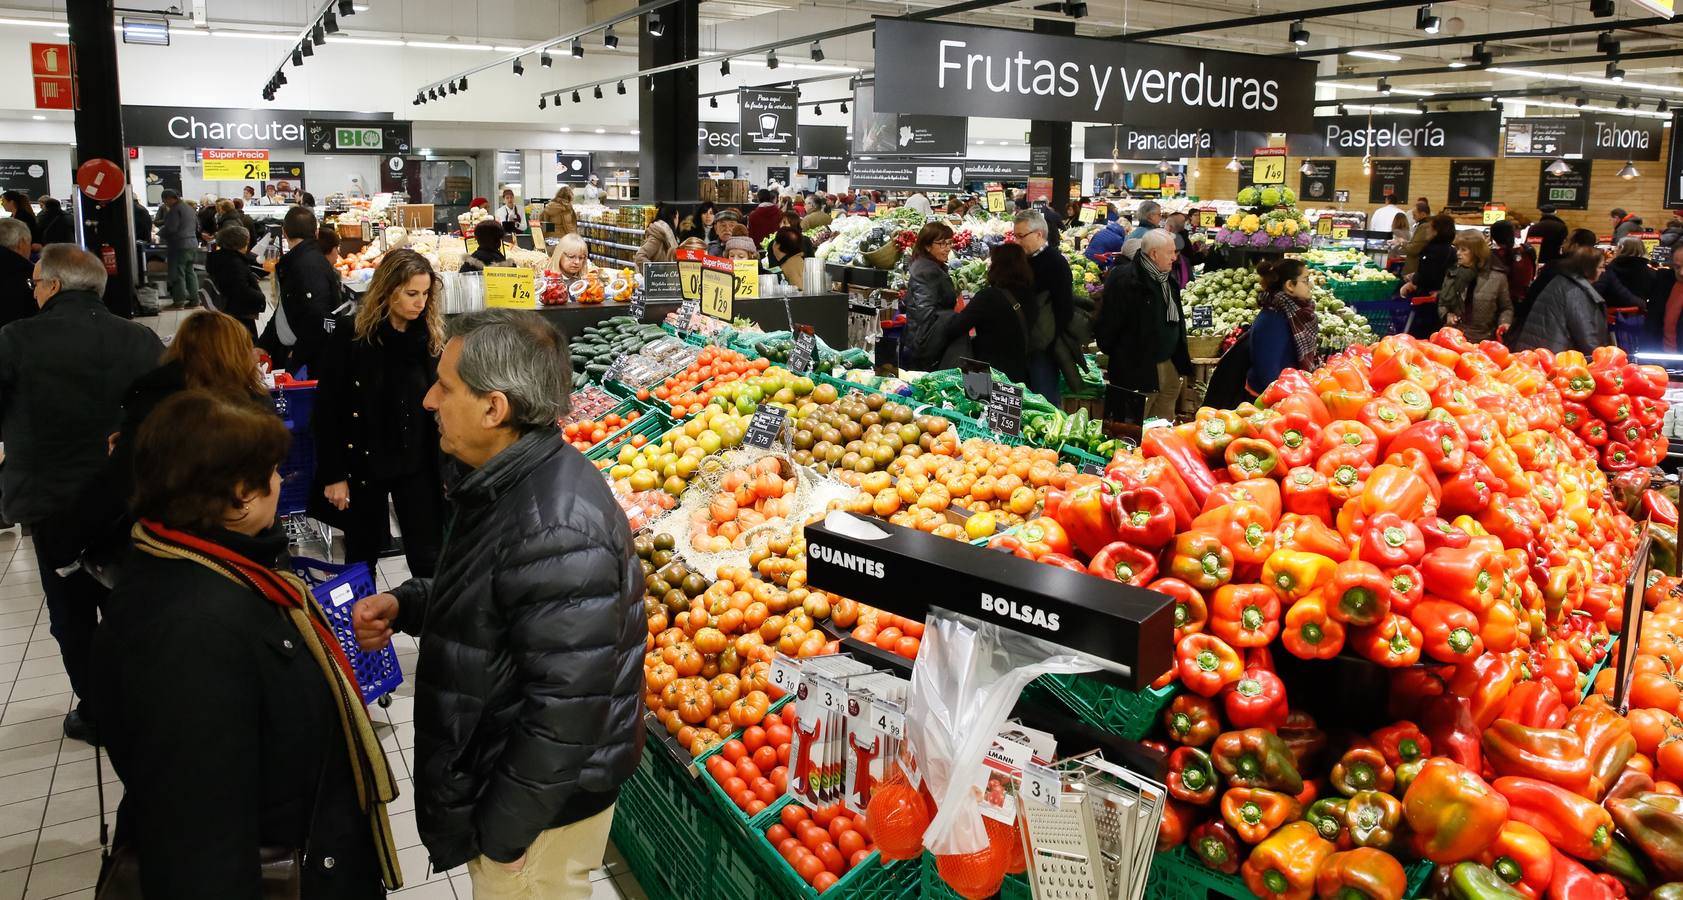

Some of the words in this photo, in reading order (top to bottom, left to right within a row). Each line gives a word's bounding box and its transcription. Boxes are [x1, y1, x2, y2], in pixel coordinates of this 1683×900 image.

[938, 39, 1080, 97] Frutas
[1089, 64, 1113, 111] y
[1120, 62, 1280, 111] verduras
[337, 130, 380, 146] BIO
[1127, 128, 1211, 150] Panadera
[1326, 120, 1445, 147] Pastelería
[1594, 121, 1650, 149] Tahona
[209, 150, 236, 159] Super
[237, 150, 265, 158] Precio
[244, 164, 255, 180] 2
[703, 257, 717, 268] Super
[718, 260, 732, 270] Precio
[741, 286, 753, 294] 75
[809, 543, 886, 579] GUANTES
[980, 592, 1060, 632] BOLSAS
[775, 670, 784, 684] 3
[786, 680, 795, 690] 10
[825, 692, 832, 706] 3
[837, 703, 844, 712] 10
[878, 715, 887, 730] 4
[988, 750, 1014, 765] LMANN
[1032, 781, 1041, 797] 3
[1047, 794, 1056, 805] 10
